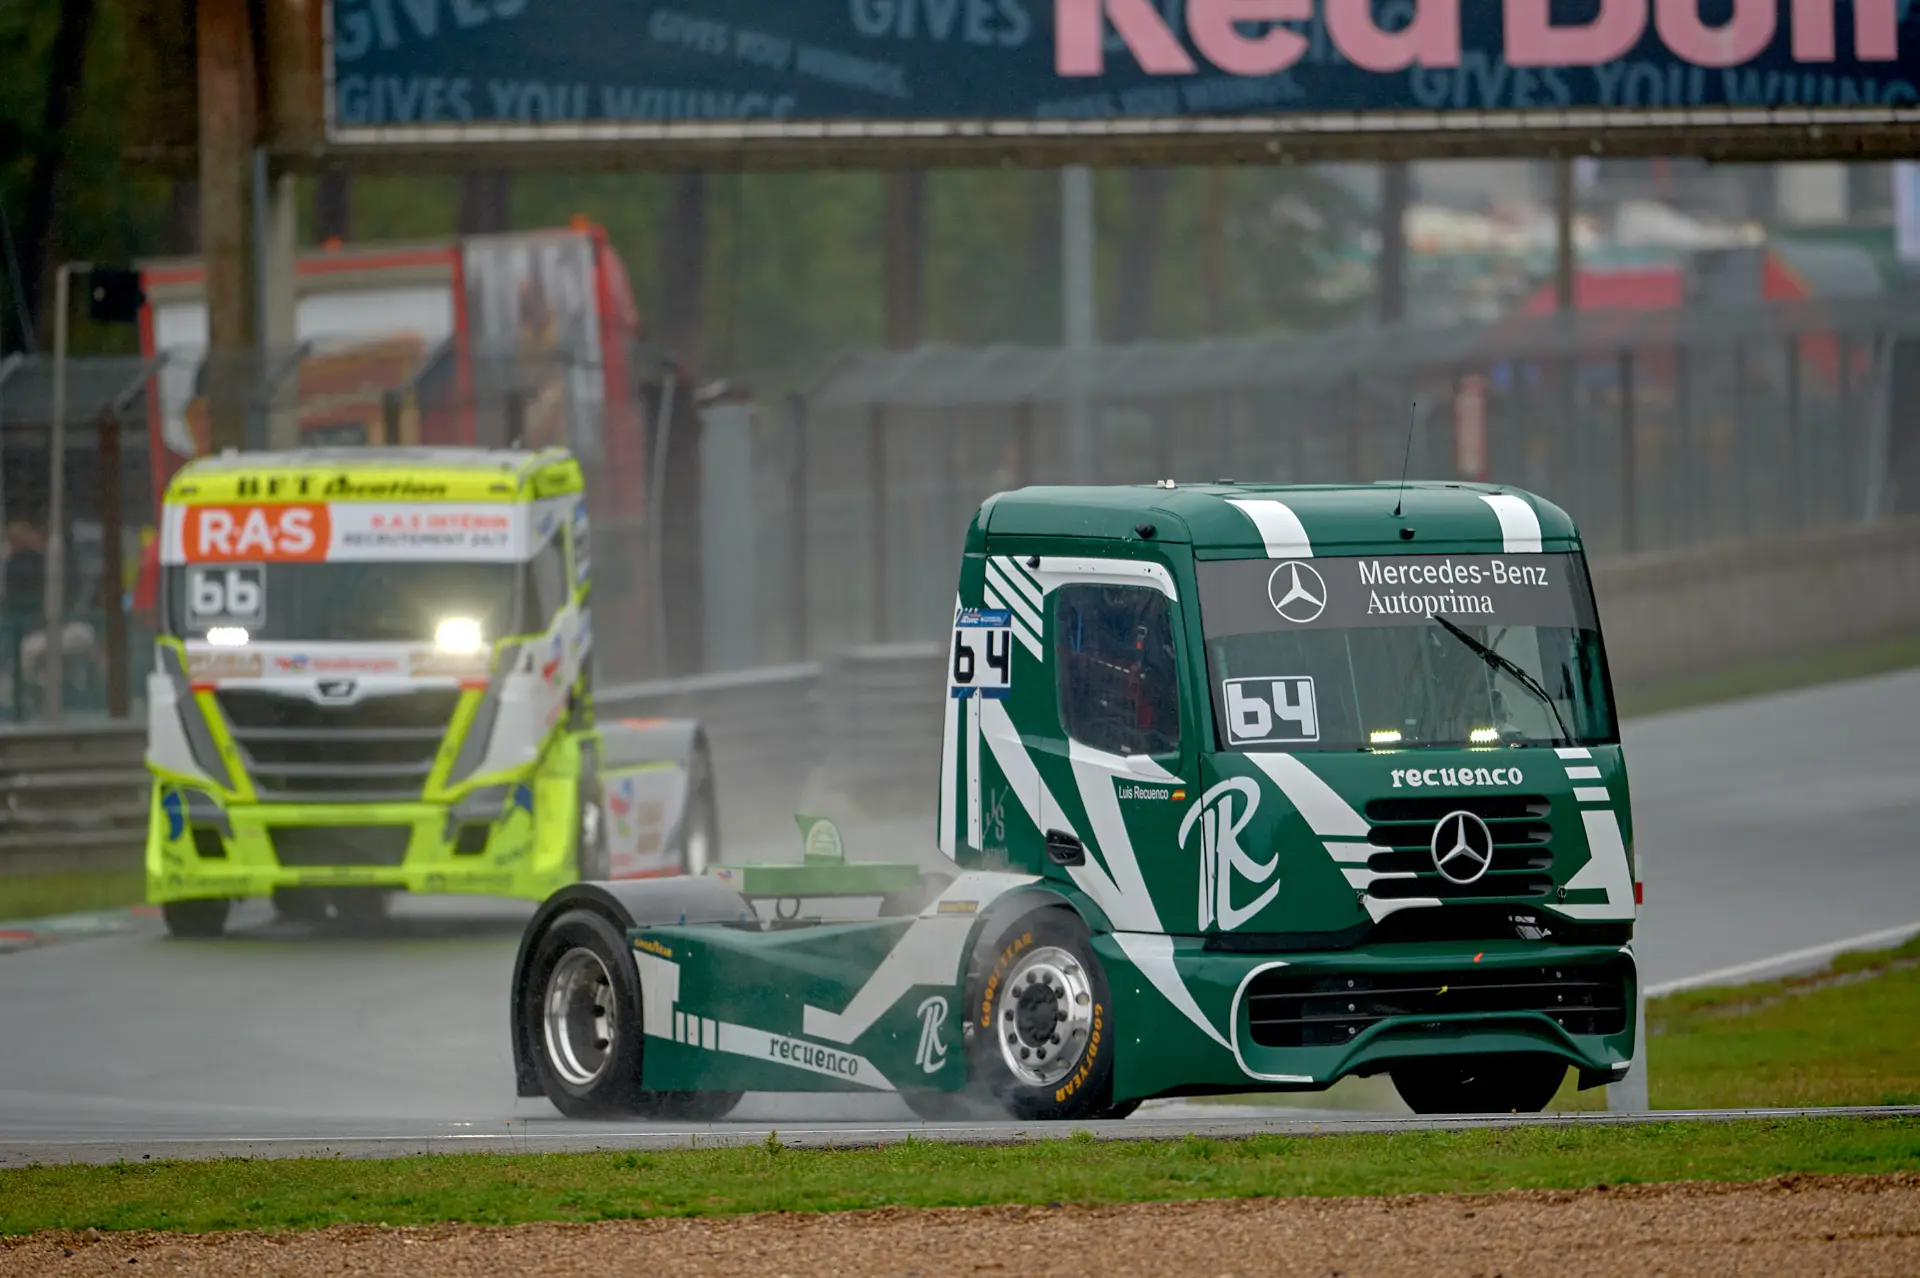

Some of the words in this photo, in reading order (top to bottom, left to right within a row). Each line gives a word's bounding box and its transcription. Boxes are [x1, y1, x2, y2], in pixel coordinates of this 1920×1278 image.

[199, 508, 317, 555] RAS
[1358, 559, 1549, 586] Mercedes-Benz
[1367, 589, 1495, 618] Autoprima
[953, 630, 1010, 684] 64
[1226, 681, 1316, 738] 64
[1118, 785, 1134, 799] Luis
[1134, 786, 1169, 800] Recuenco
[1391, 766, 1523, 788] recuenco
[769, 1037, 858, 1076] recuenco
